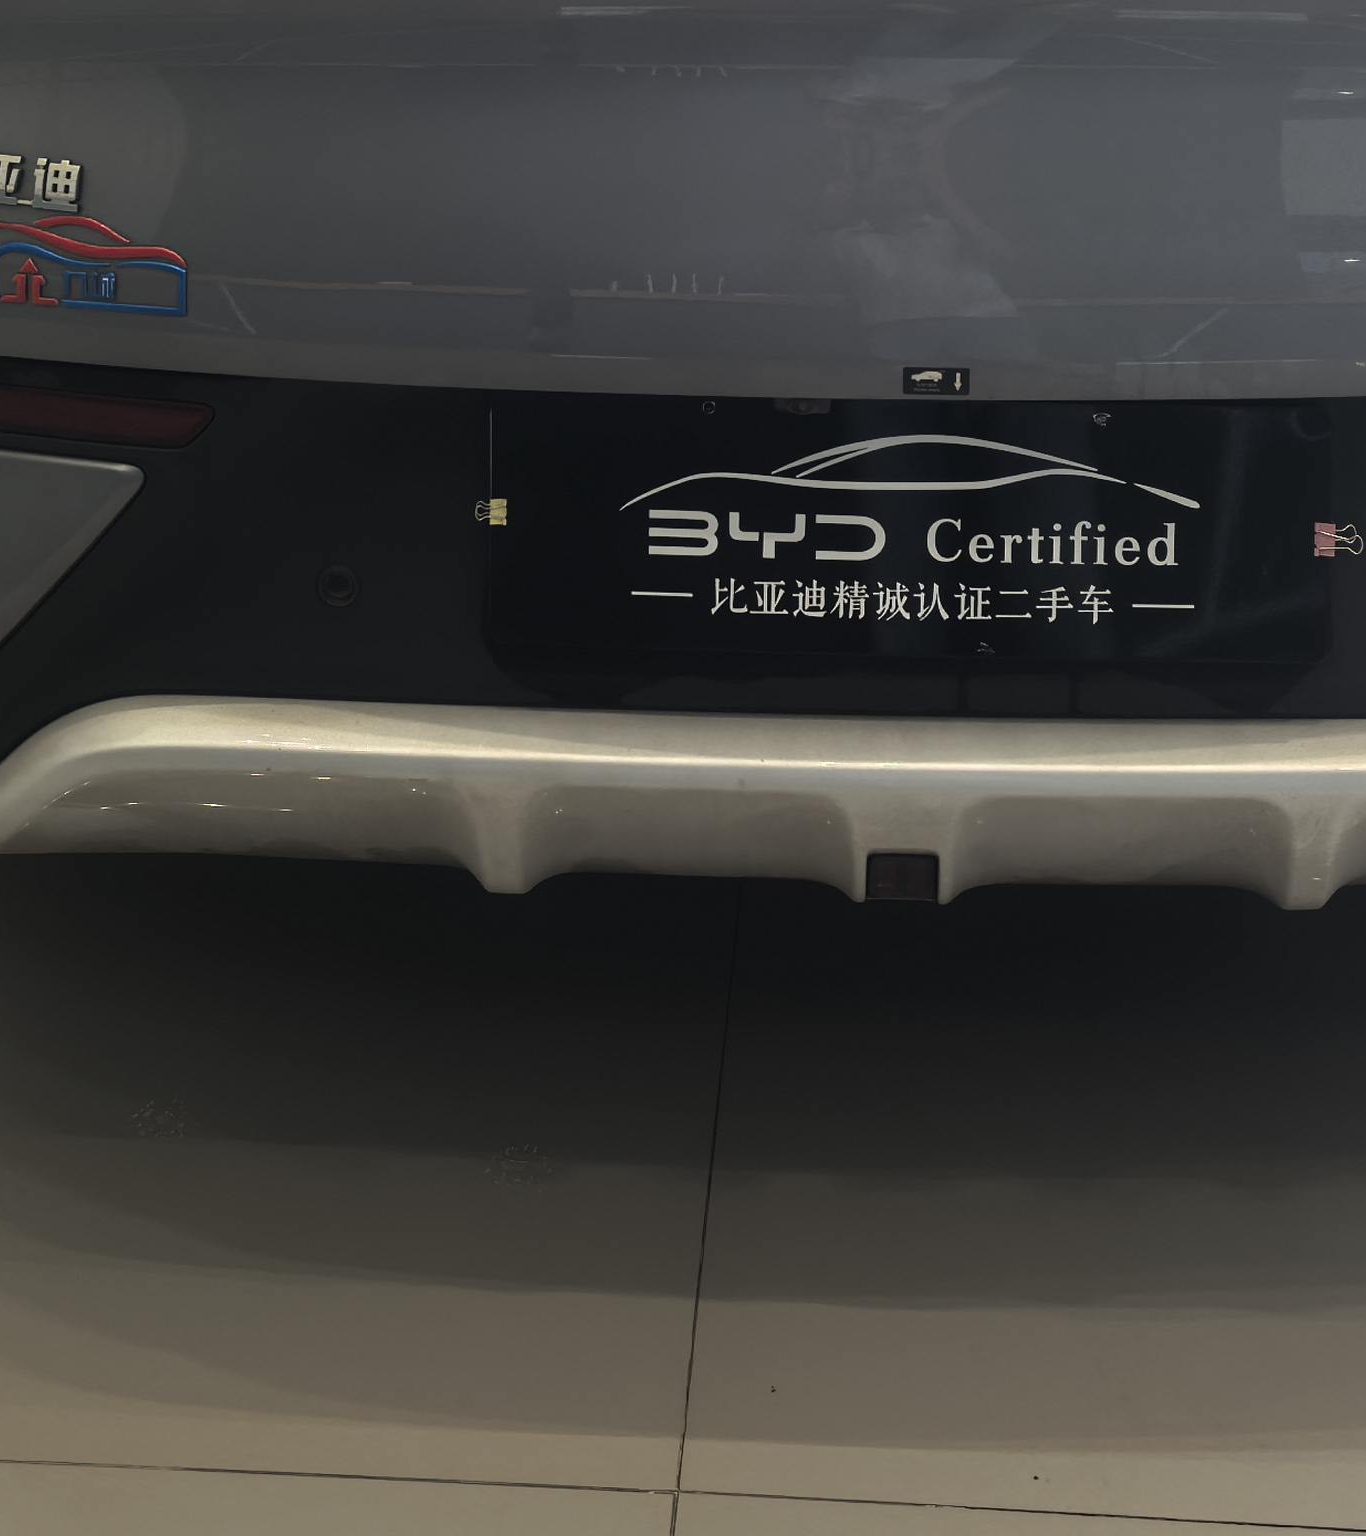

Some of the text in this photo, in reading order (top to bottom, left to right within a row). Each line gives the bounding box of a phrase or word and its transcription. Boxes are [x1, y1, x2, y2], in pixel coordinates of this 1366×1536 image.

[648, 508, 1180, 566] BYD Certified
[710, 577, 1115, 625] 比亚迪精诚认证二手车
